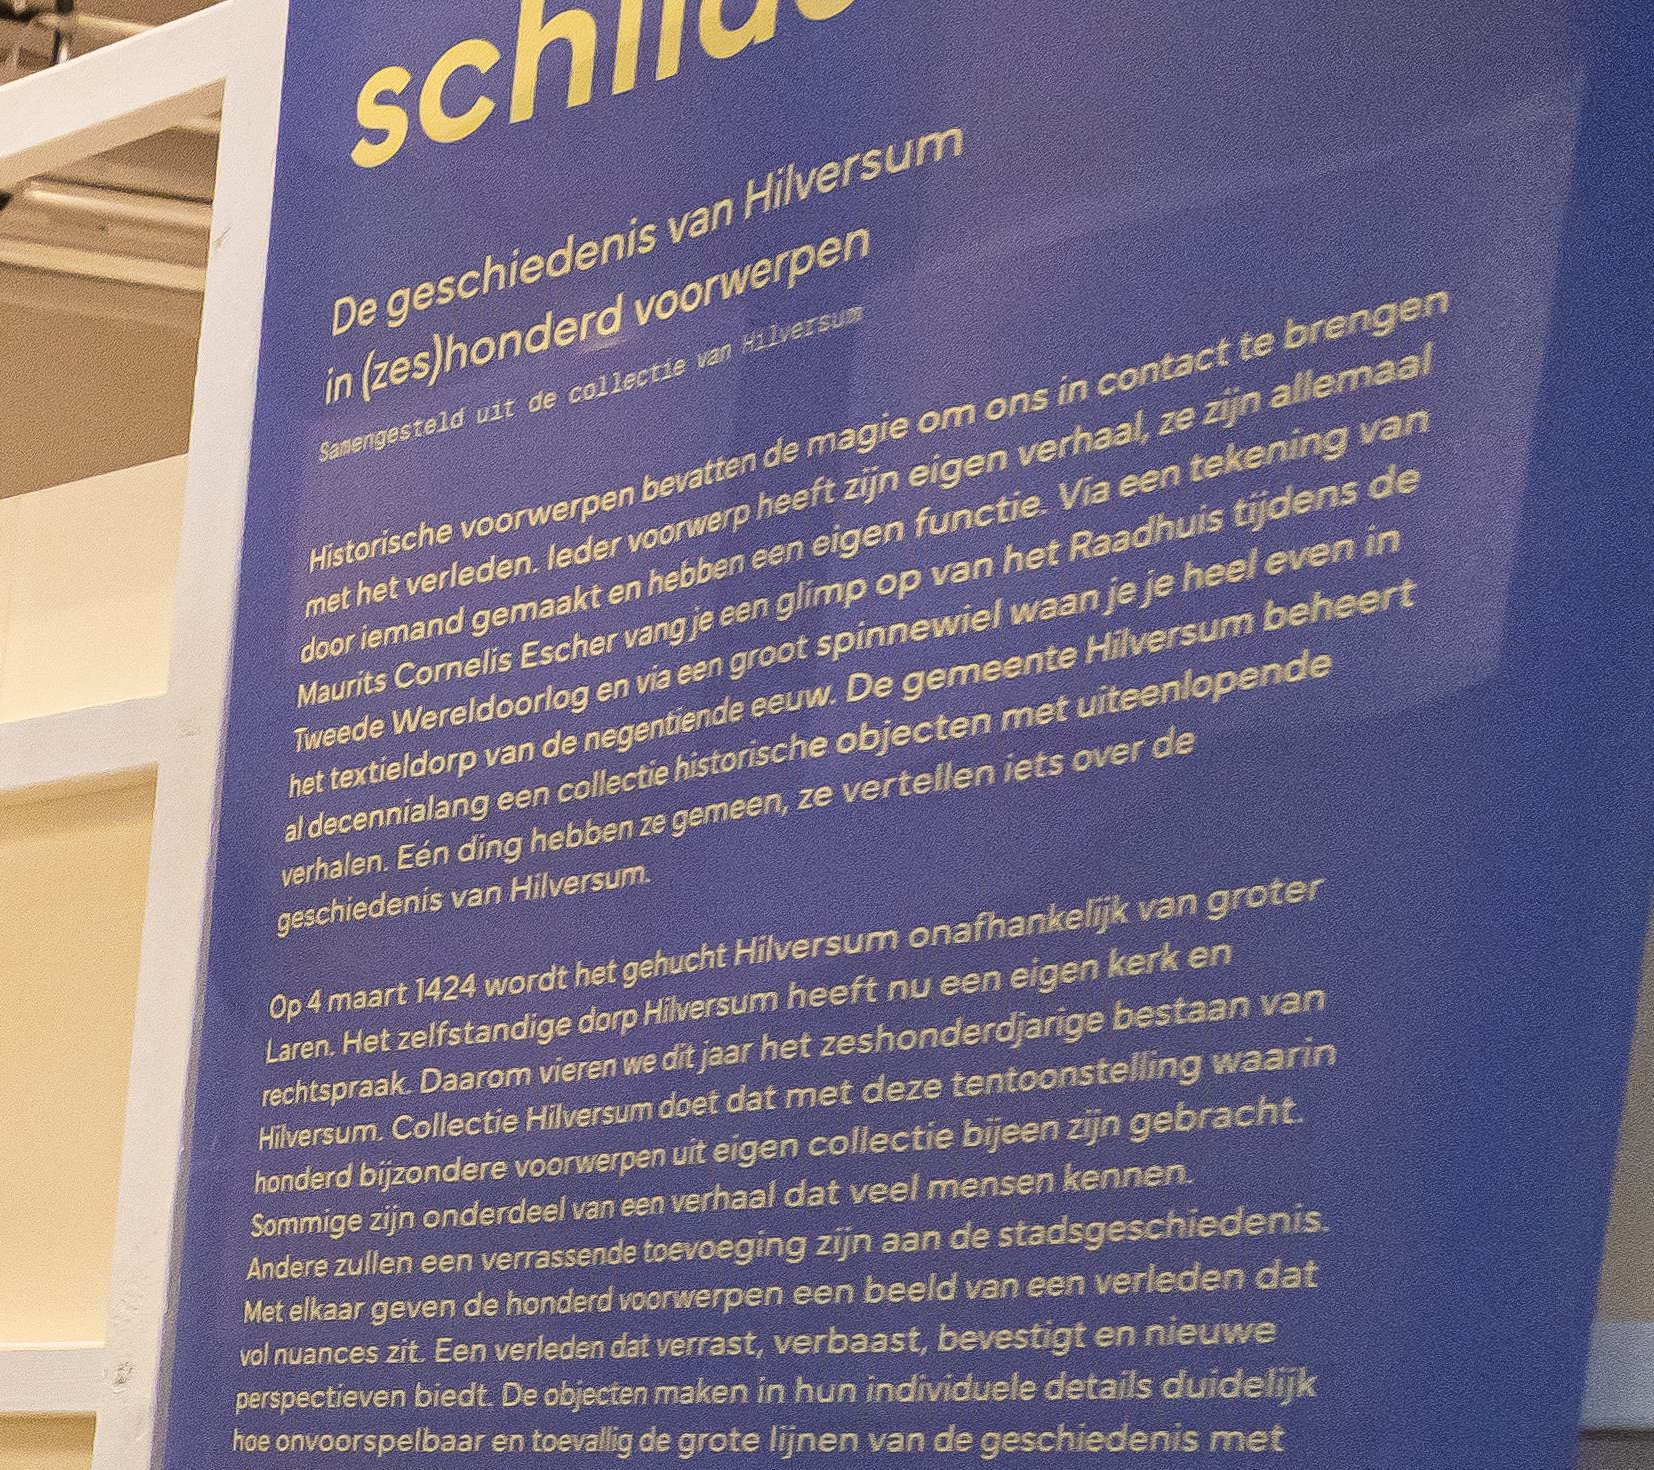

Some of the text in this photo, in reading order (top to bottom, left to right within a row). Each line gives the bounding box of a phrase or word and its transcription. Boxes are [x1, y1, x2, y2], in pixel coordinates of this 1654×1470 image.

[325, 229, 870, 404] in (zes)honderd voorwerpen
[331, 128, 963, 337] De geschiedenis van Hilversum
[309, 291, 1449, 570] Historische voorwerpen bevatten de magie om ons in contact te brengen
[319, 306, 863, 462] Samengesteld uit de collectie van Hilversum
[304, 344, 1432, 617] met het verleden. Ieder voorwerp heeft zijn eigen verhaal, ze zijn allemaal
[268, 878, 1322, 1023] Op 4 maart 1424 wordt het gehucht Hilversum onafhankelijk van groter
[251, 1163, 1196, 1240] Sommige zijn onderdeel van een verhaal dat veel mensen kennen.
